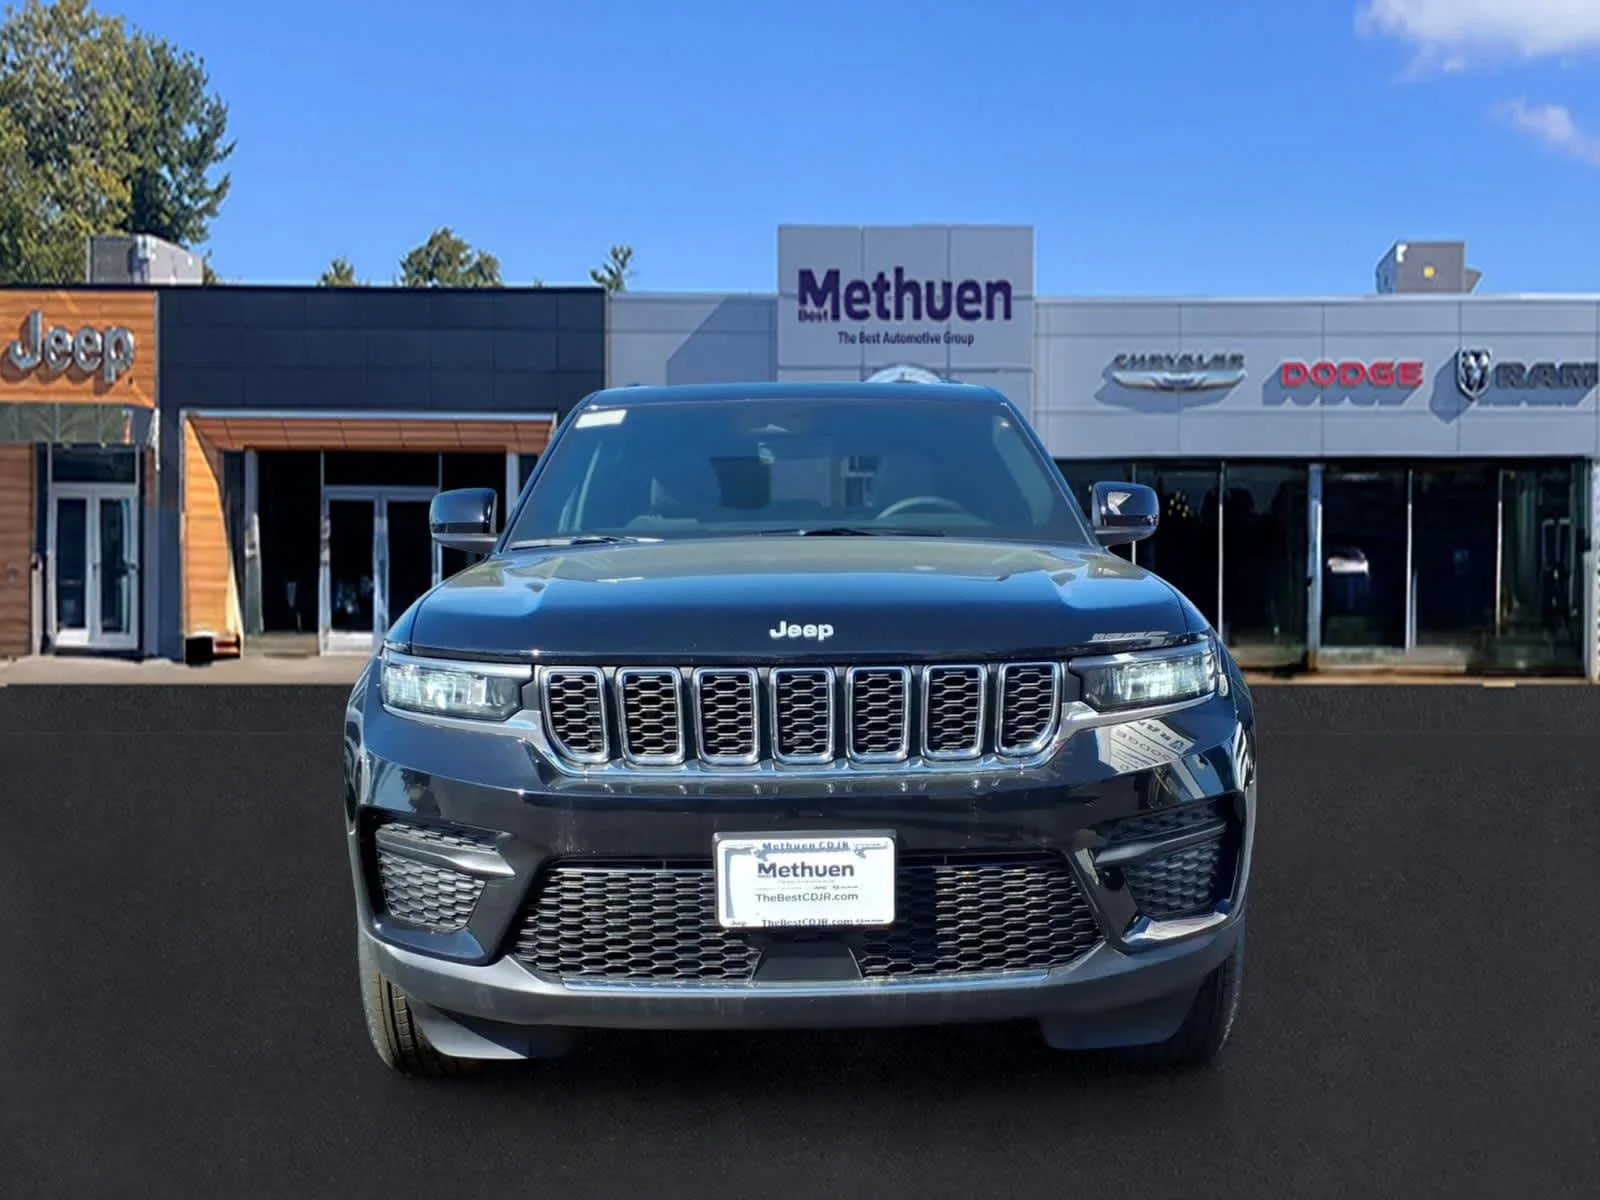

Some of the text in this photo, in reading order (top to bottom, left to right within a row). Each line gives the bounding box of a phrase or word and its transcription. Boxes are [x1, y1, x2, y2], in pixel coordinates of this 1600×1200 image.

[798, 266, 1012, 322] Methuen
[9, 311, 135, 383] Jeep
[838, 331, 974, 347] The Best Automotive Group
[1281, 361, 1423, 386] DODGE
[1495, 362, 1598, 389] RAM
[769, 620, 834, 642] Jeep
[762, 842, 815, 850] Methuen
[757, 861, 854, 878] Methuen
[755, 892, 859, 903] TheBestCDJR.com
